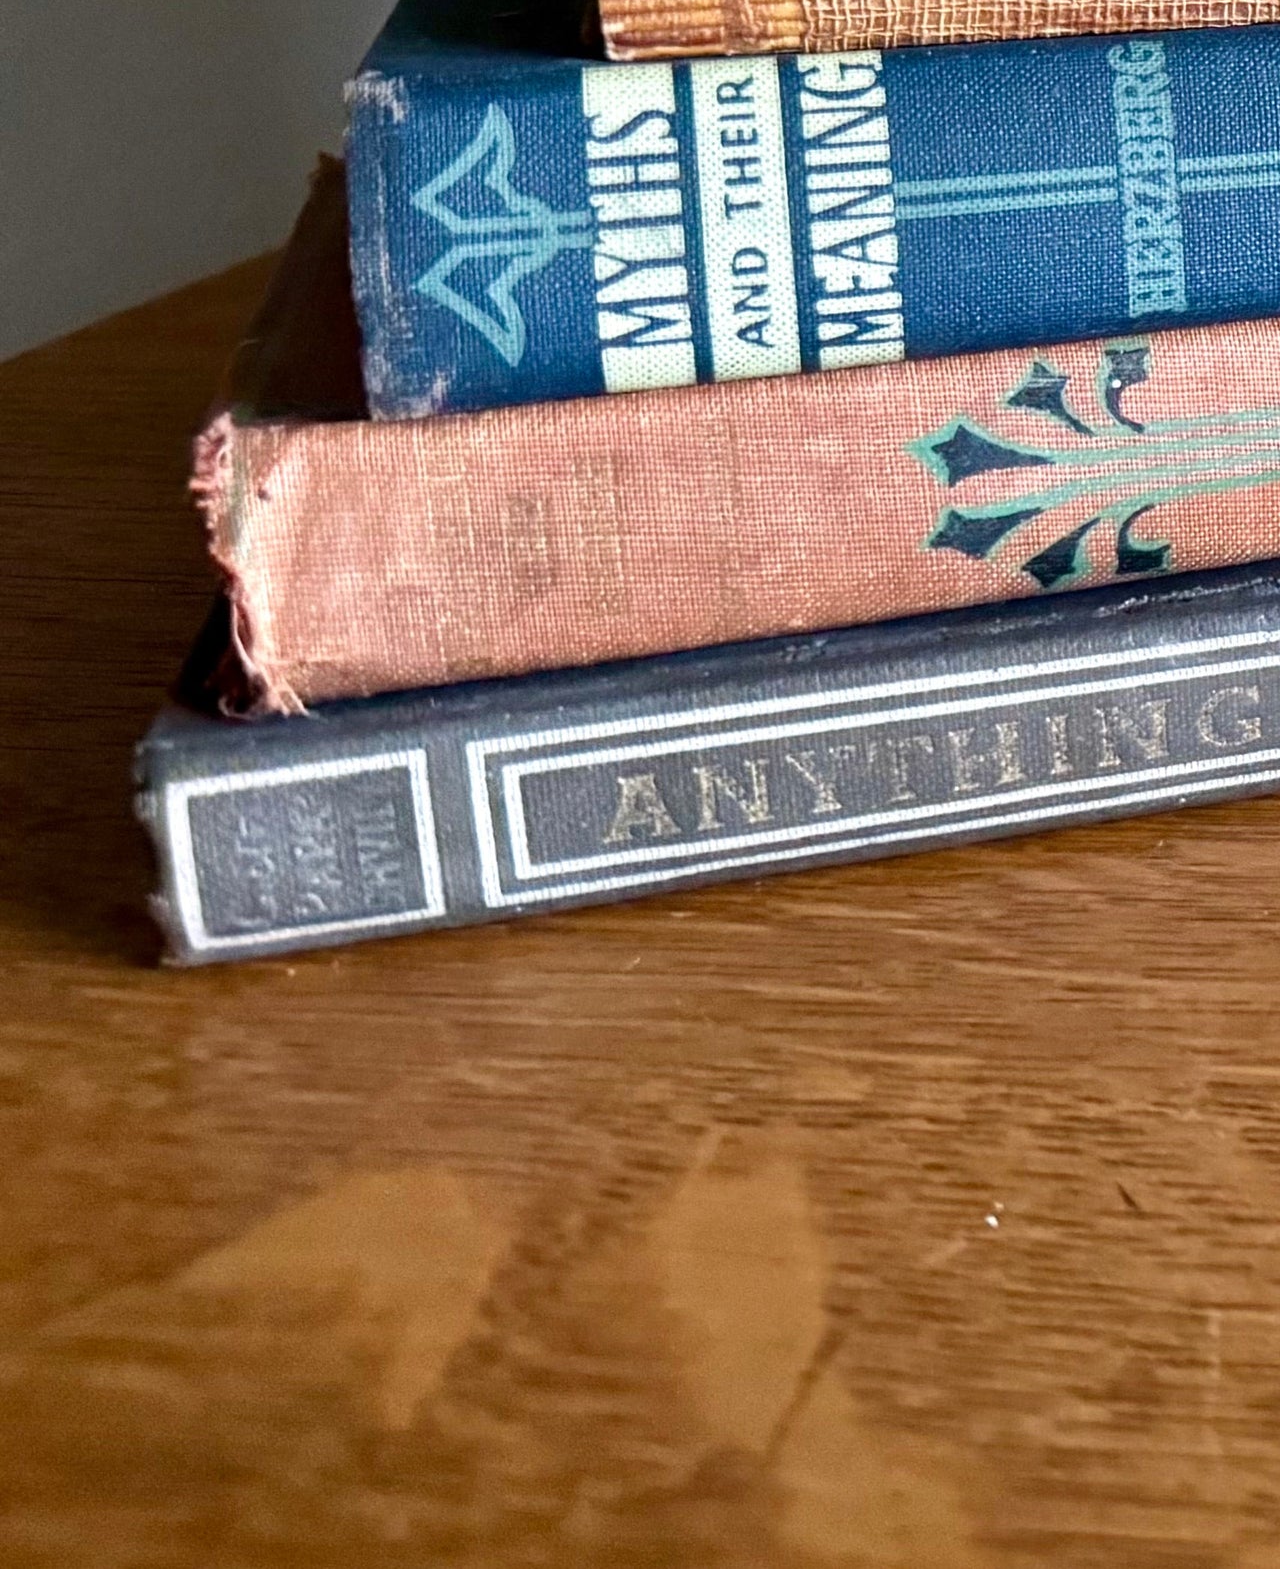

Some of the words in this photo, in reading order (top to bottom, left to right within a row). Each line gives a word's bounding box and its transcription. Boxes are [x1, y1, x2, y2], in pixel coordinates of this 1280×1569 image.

[586, 110, 692, 349] MYTHS
[716, 76, 762, 219] THEIR
[801, 63, 903, 348] MEANING
[1107, 40, 1187, 318] HERZBERG
[732, 247, 775, 348] AND
[602, 684, 1262, 842] ANYTHING
